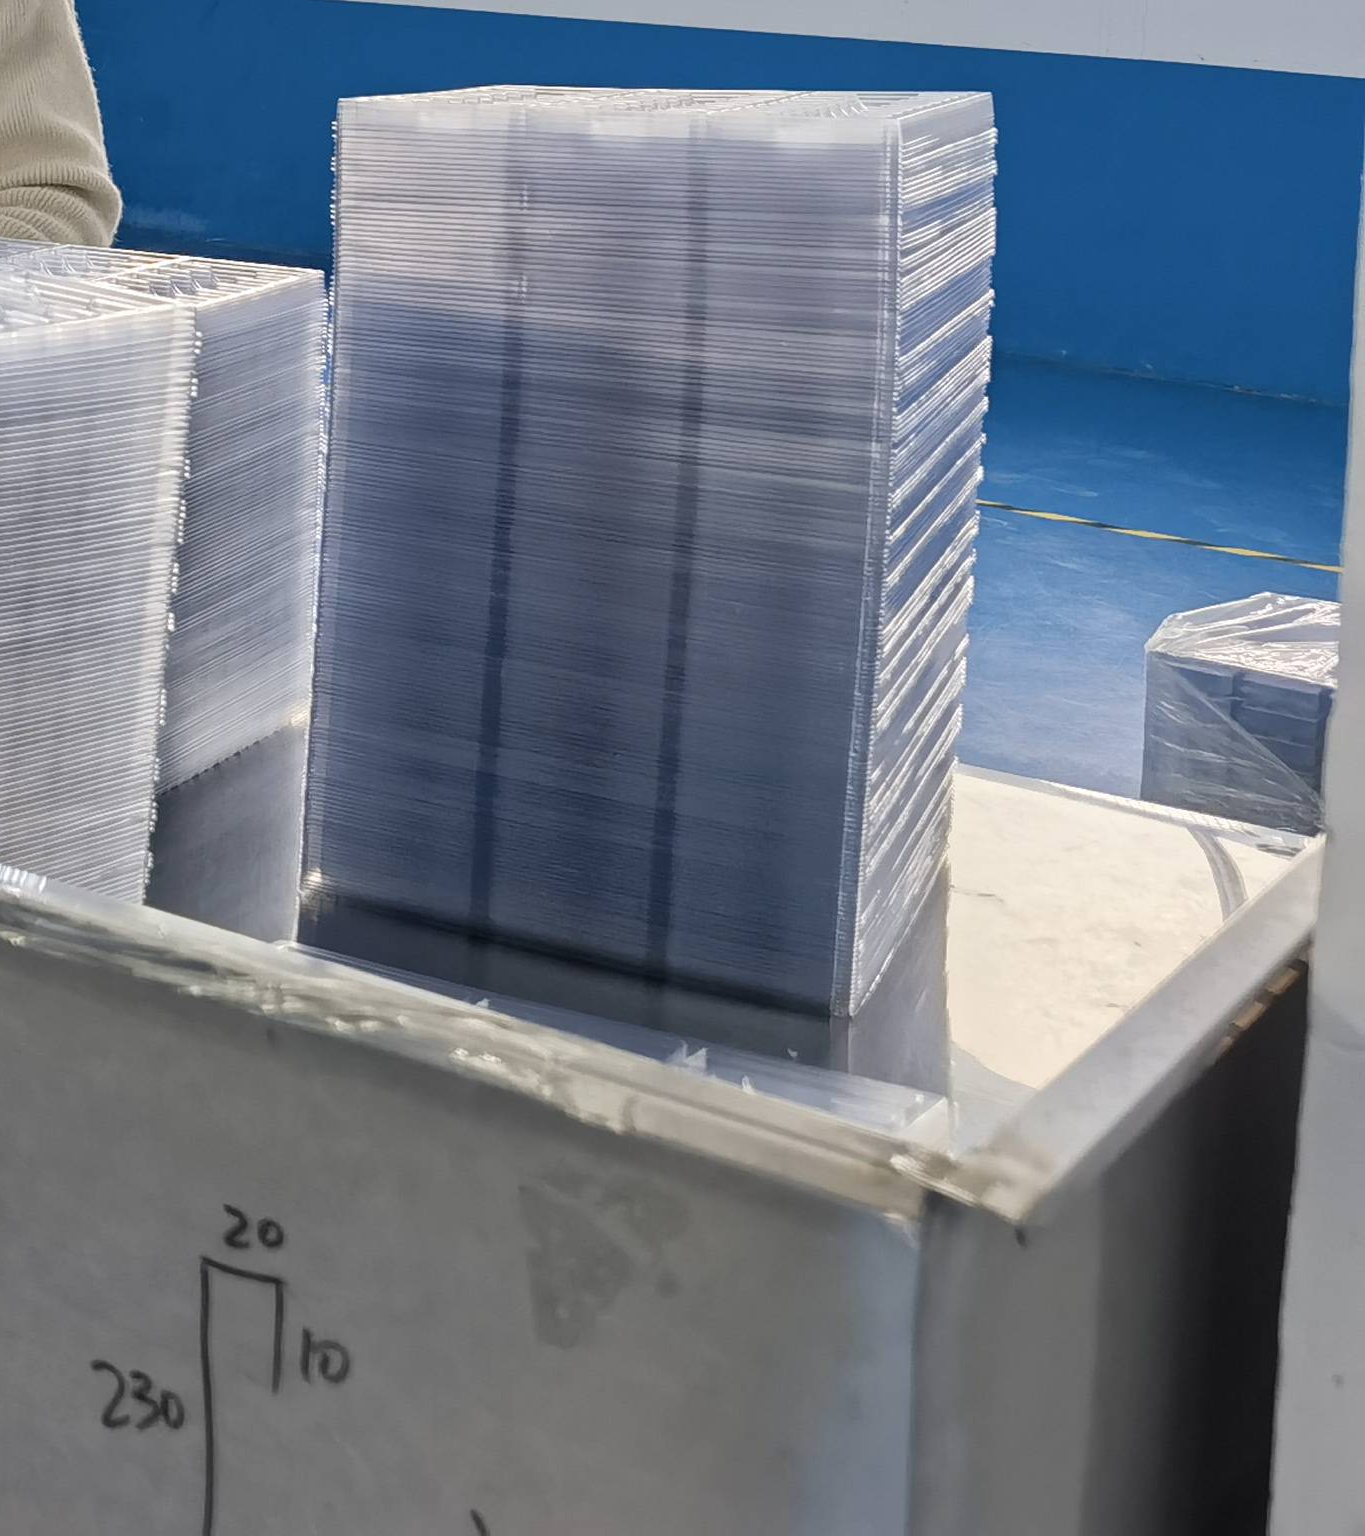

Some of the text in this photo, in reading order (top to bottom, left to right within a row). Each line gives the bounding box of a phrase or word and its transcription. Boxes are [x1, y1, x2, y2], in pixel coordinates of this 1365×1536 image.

[223, 1204, 284, 1250] 20
[301, 1327, 351, 1385] 10
[90, 1359, 186, 1429] 230
